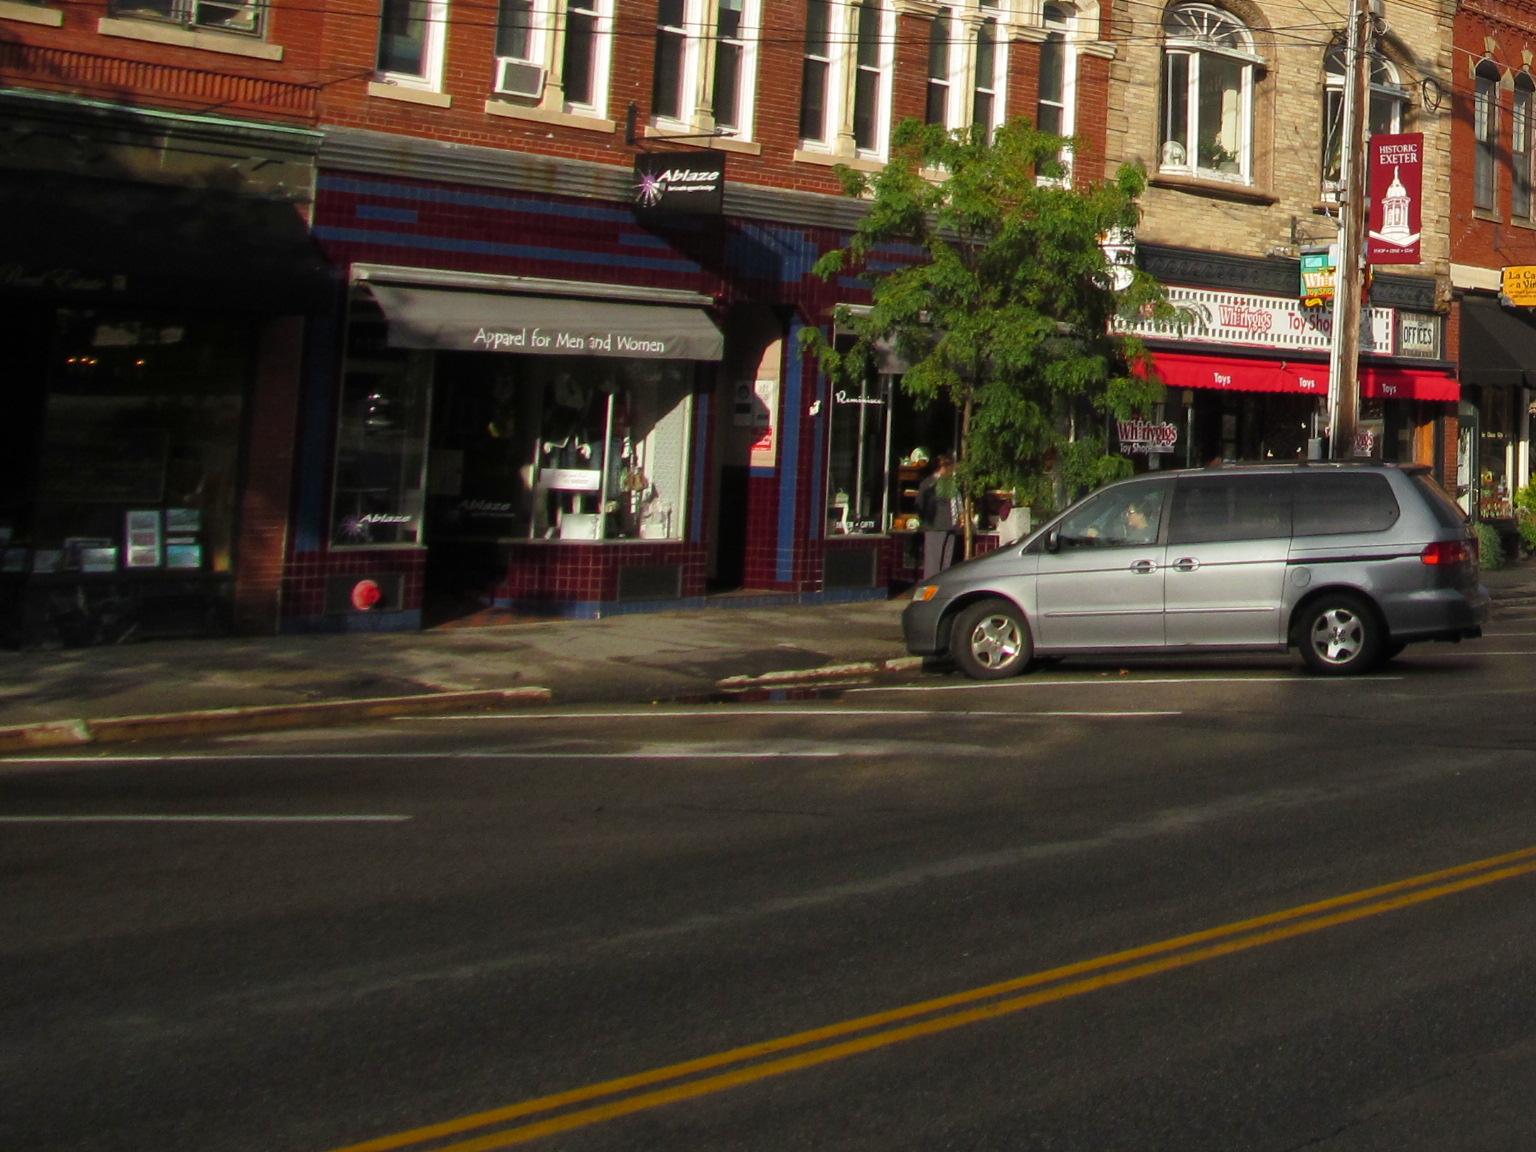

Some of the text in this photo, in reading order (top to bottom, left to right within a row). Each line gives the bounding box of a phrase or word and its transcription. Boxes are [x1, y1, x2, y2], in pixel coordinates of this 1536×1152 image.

[1379, 144, 1417, 154] HISTORIC
[1380, 153, 1417, 164] EXETER
[656, 169, 720, 182] Ablaze
[1508, 271, 1520, 280] La
[1219, 303, 1273, 334] Whirlygigs
[1287, 312, 1307, 334] Toy
[473, 327, 665, 353] Apparel for Men and Women
[1403, 326, 1432, 345] OFFICES
[1213, 372, 1231, 386] Toys
[1299, 376, 1315, 389] Toys
[1381, 383, 1397, 396] Toys
[360, 513, 412, 523] Ablaze
